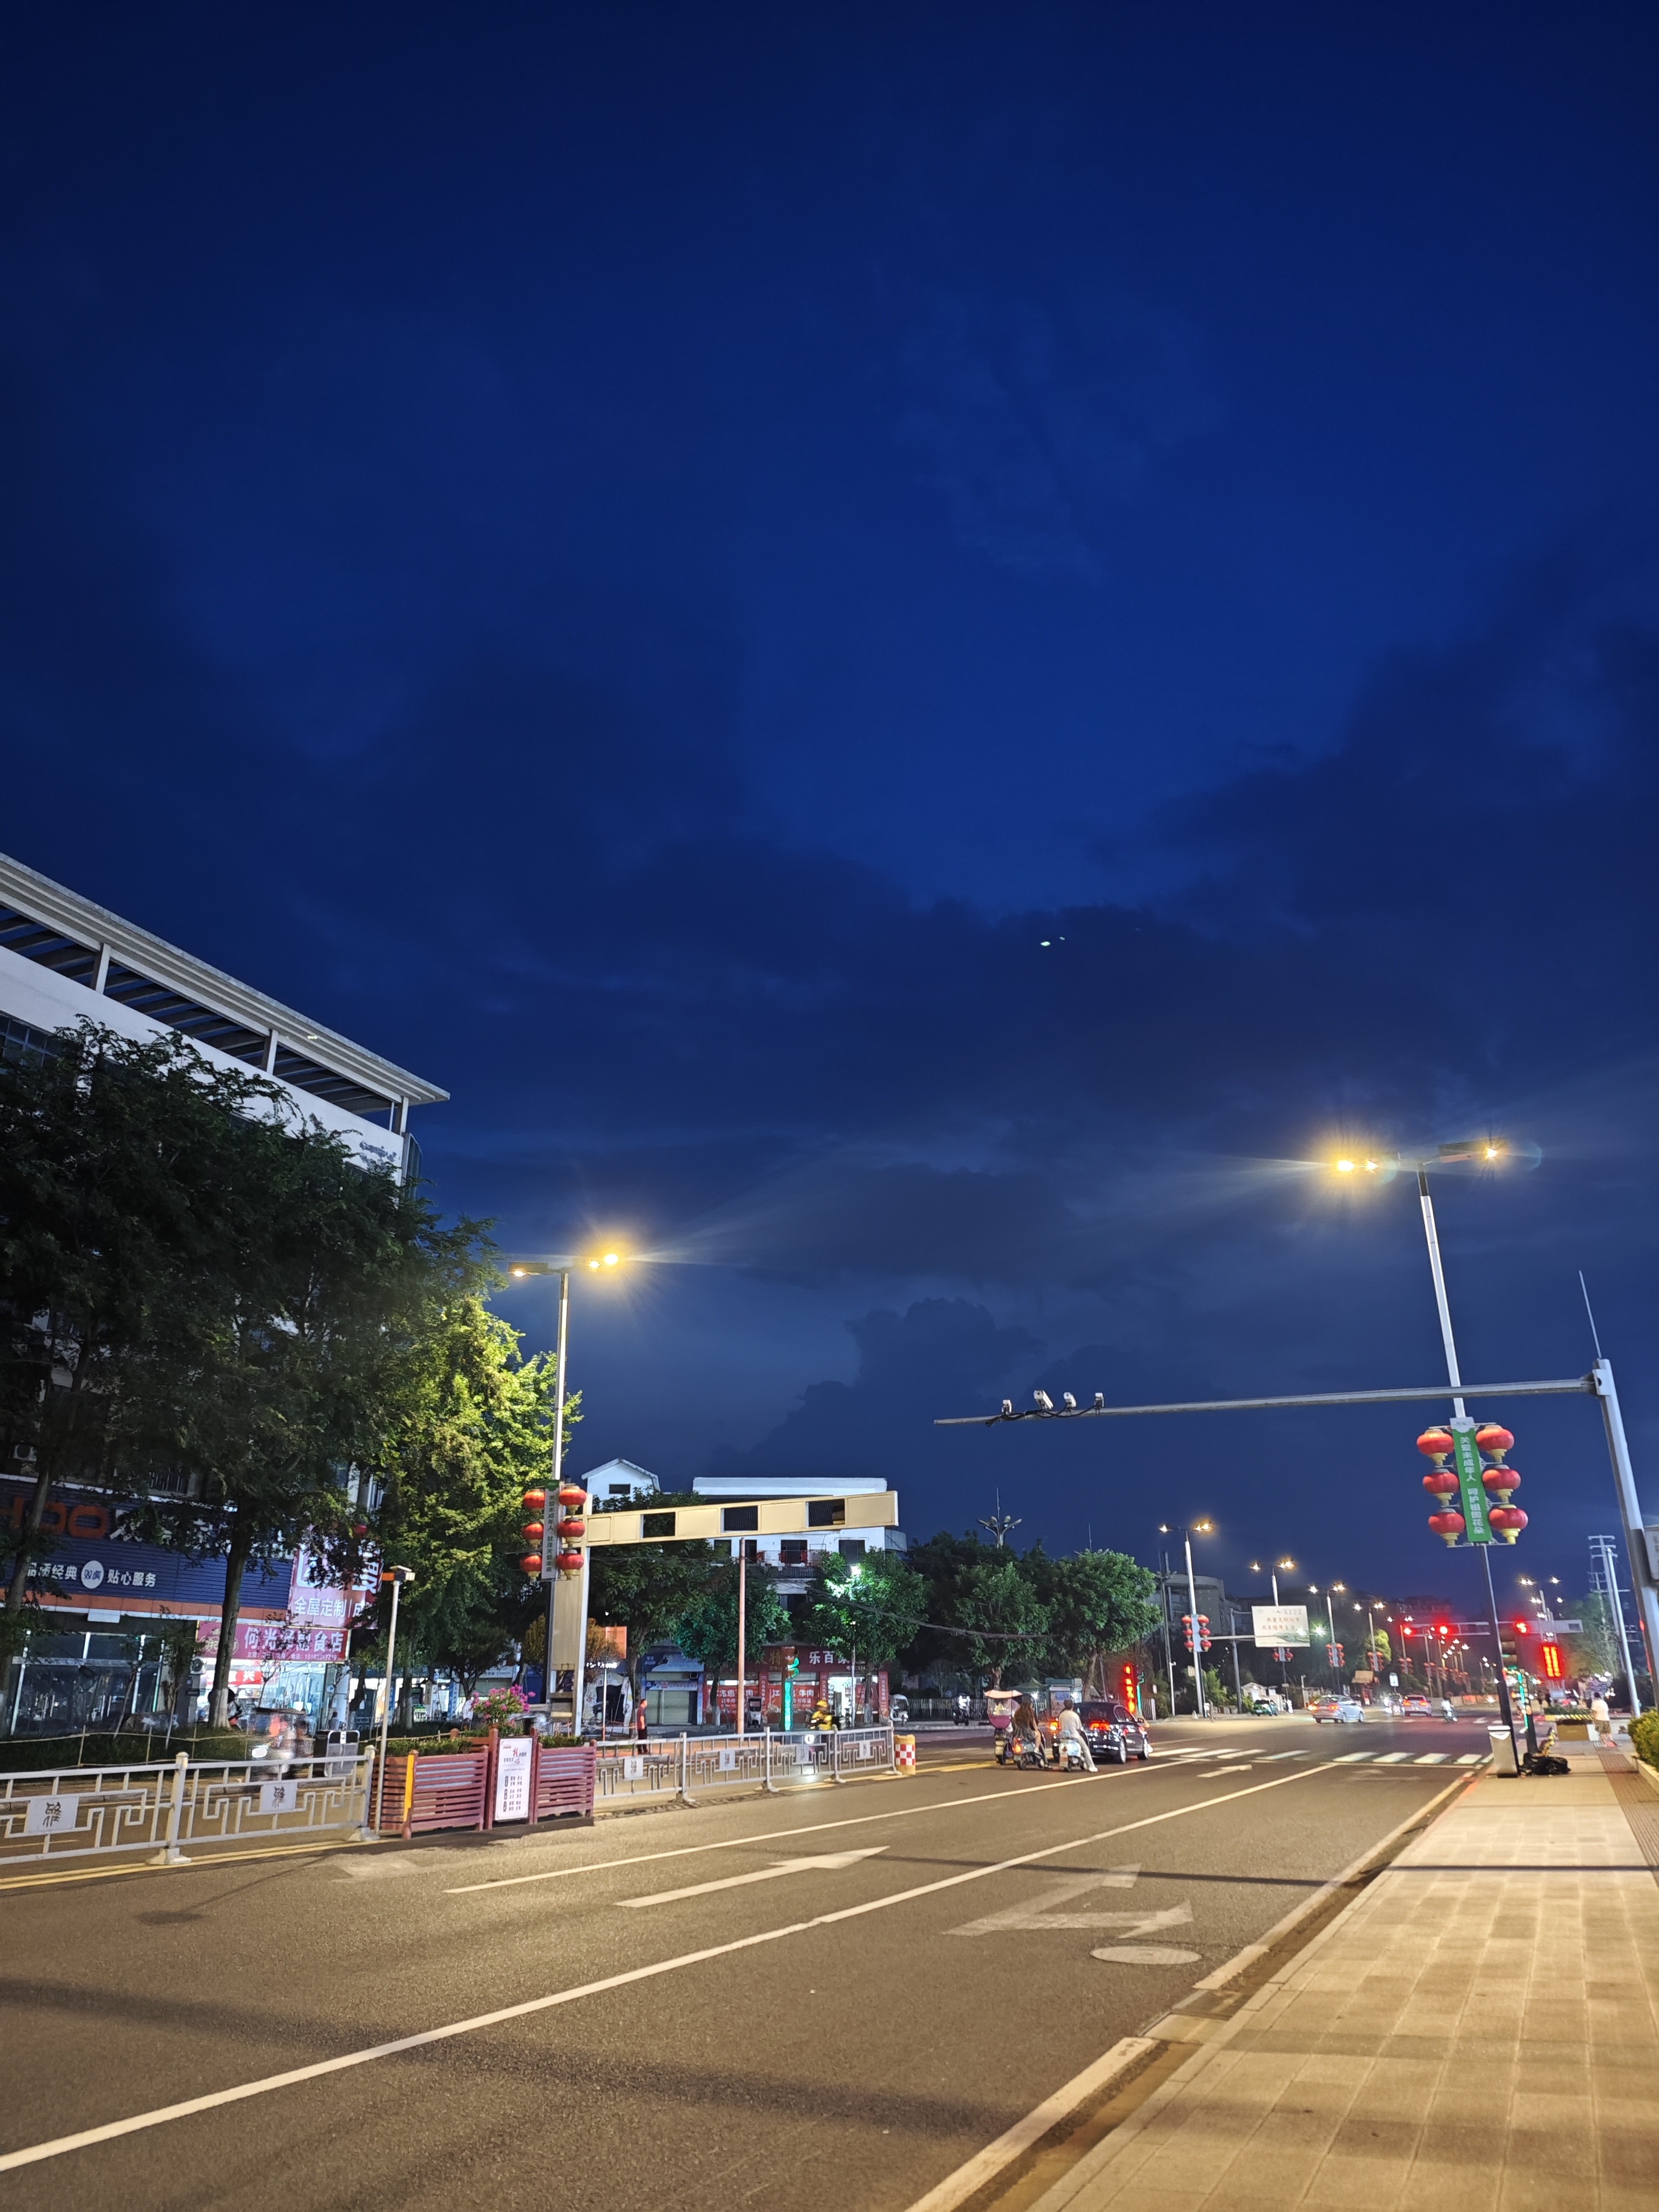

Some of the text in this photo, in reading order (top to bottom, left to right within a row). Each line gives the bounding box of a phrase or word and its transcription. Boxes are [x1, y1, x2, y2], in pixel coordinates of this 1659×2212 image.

[107, 1569, 157, 1588] 贴心服务
[294, 1596, 347, 1618] 全屋定制
